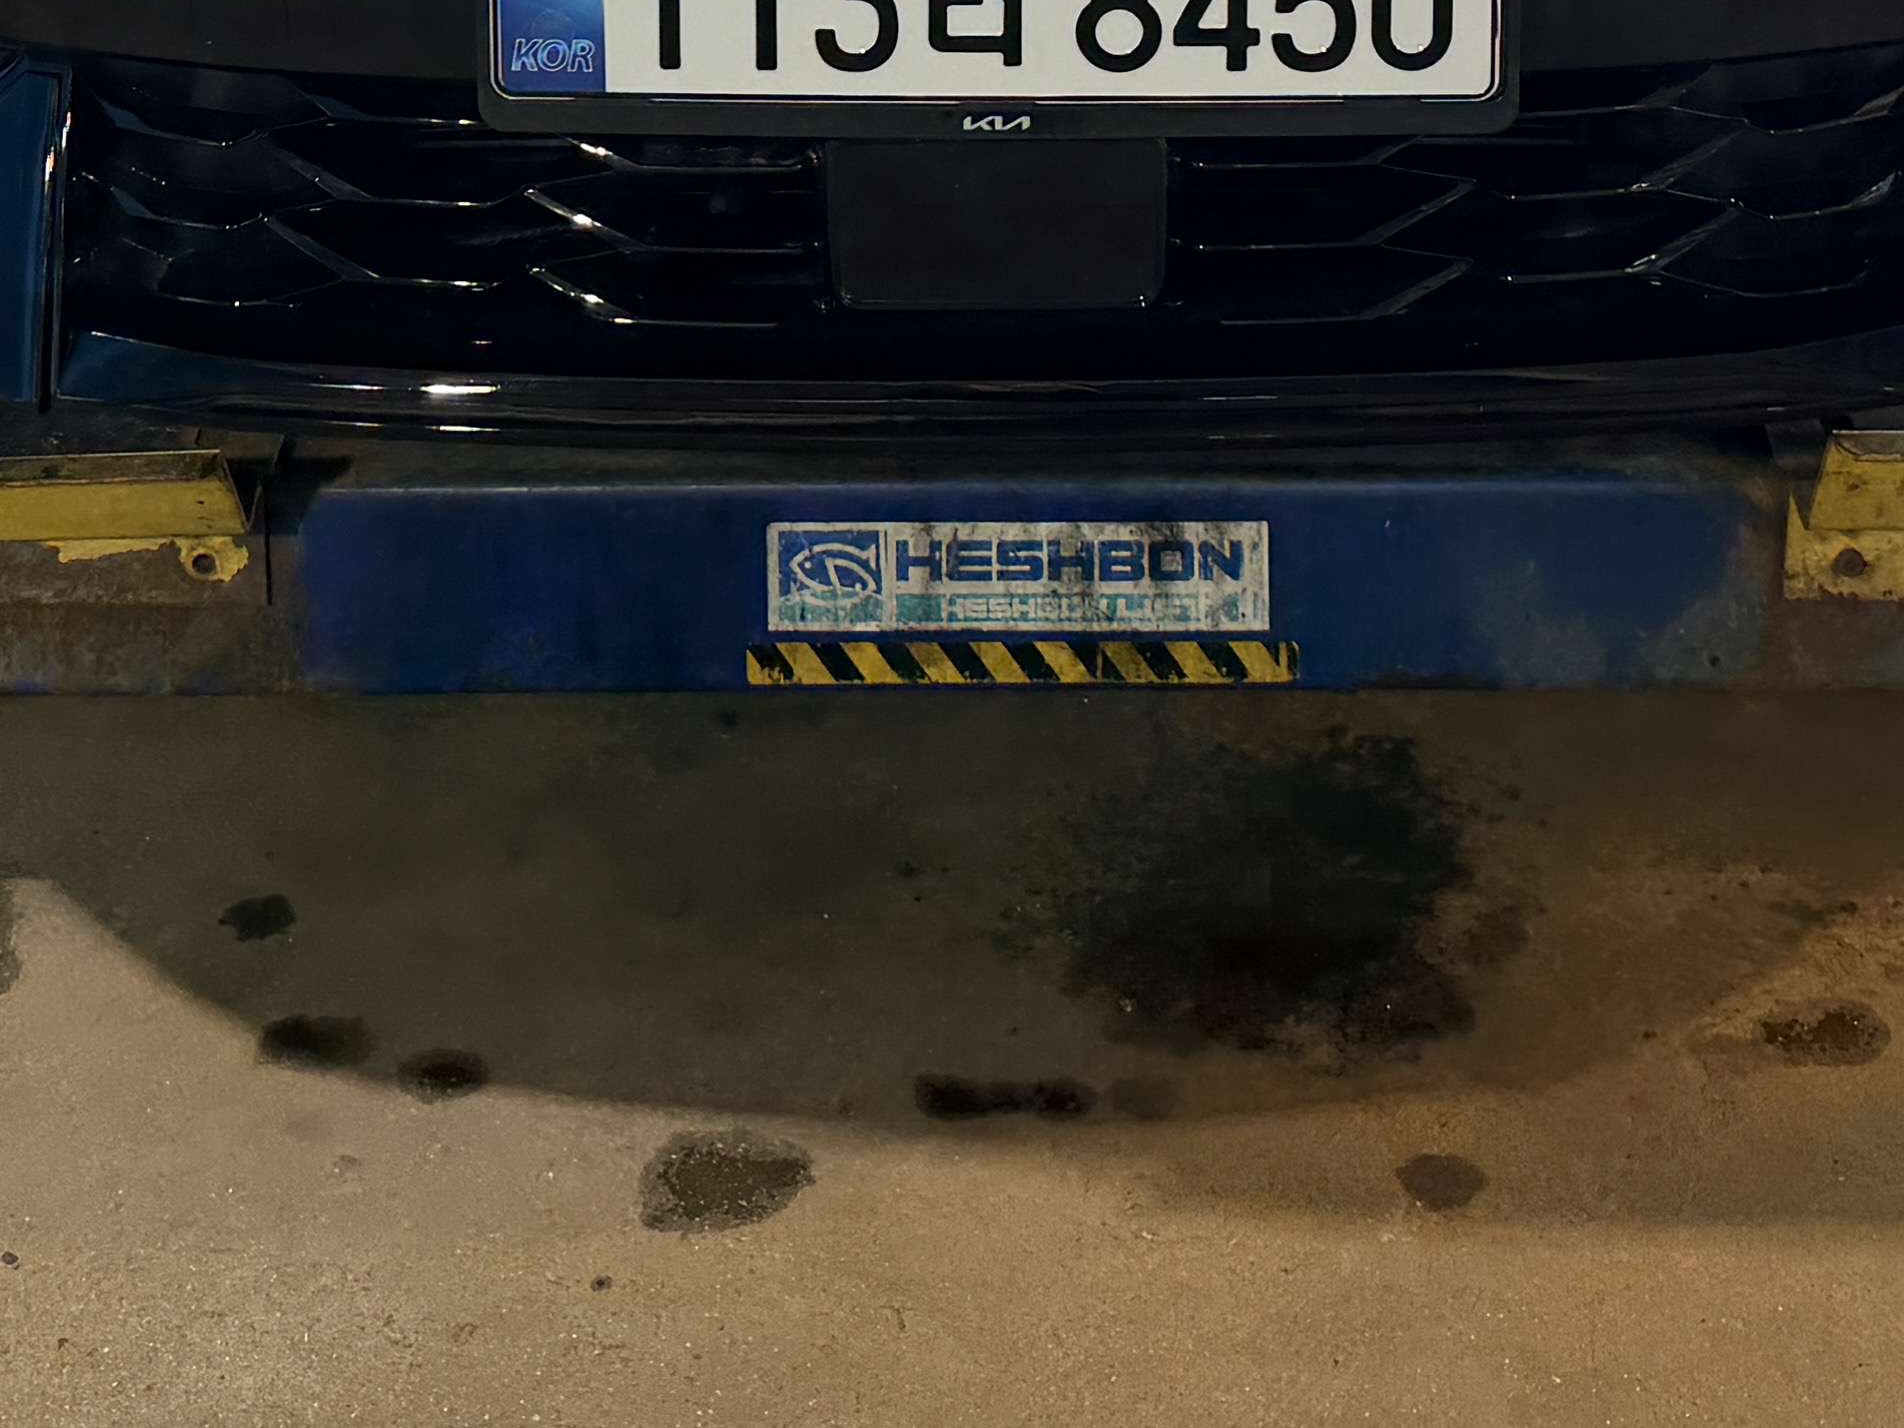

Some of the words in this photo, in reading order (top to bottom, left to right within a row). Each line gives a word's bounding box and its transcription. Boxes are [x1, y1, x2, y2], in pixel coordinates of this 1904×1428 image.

[511, 38, 596, 72] KOR
[963, 115, 1031, 131] KIA
[896, 539, 1243, 583] HESHBON
